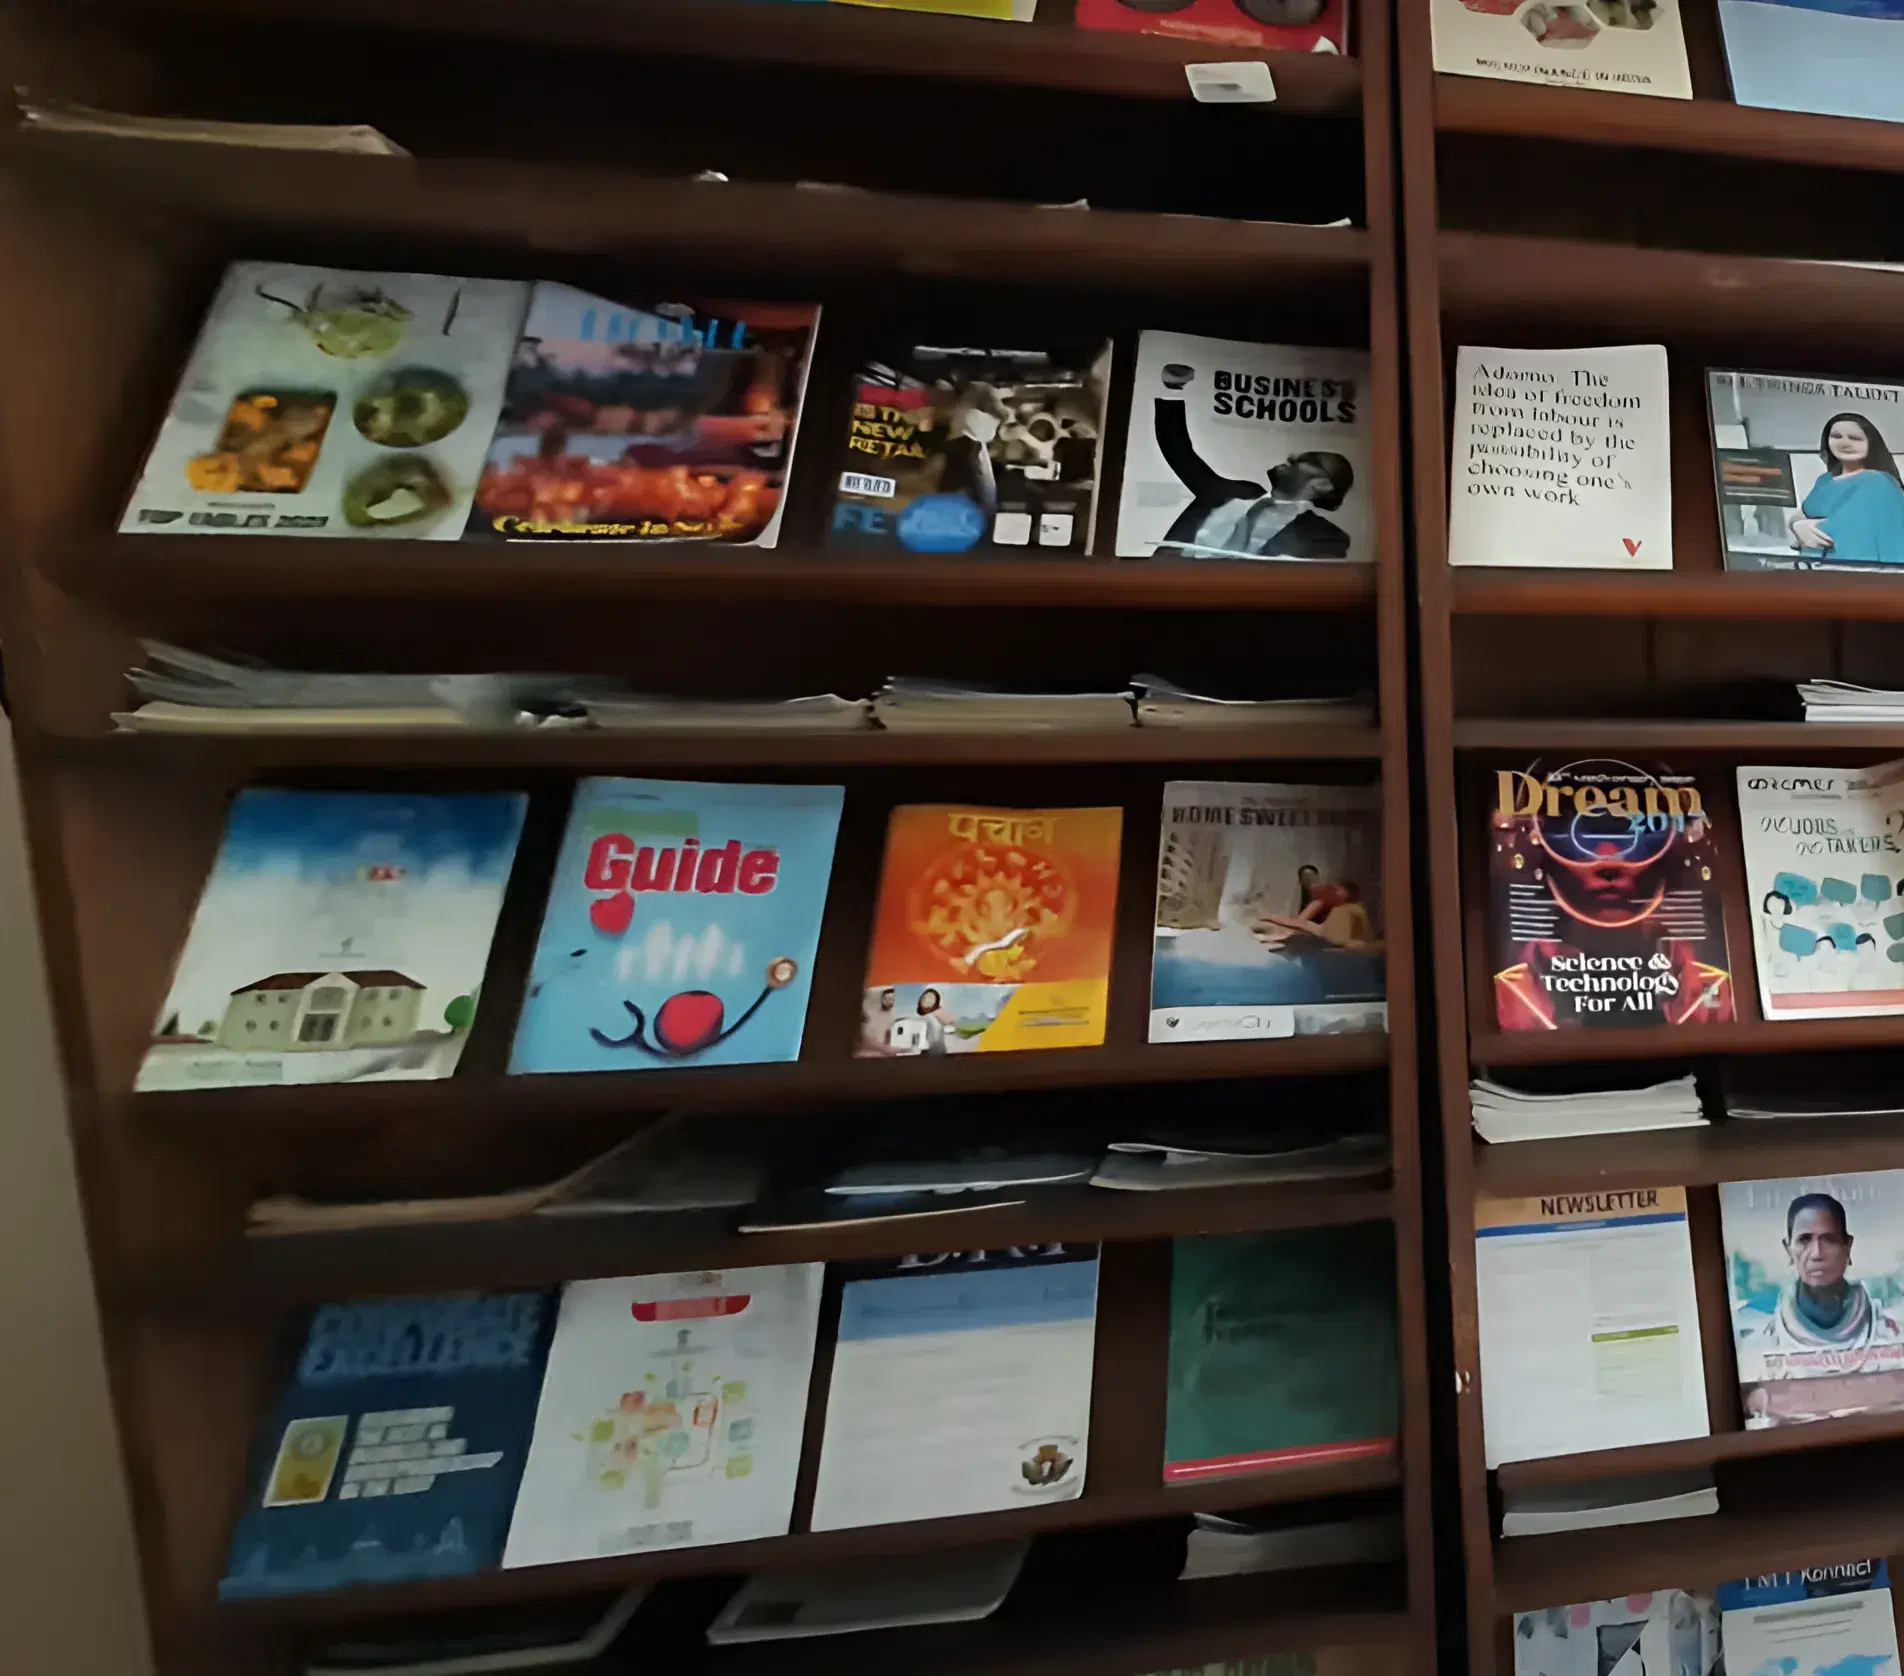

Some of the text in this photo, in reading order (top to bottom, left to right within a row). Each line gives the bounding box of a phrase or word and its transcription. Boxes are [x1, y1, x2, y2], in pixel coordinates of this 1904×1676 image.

[1213, 370, 1358, 400] BUSINESS
[1571, 370, 1609, 387] The
[1213, 392, 1358, 424] SCHOOLS
[1525, 388, 1548, 403] of
[1555, 388, 1642, 409] freedom
[1472, 402, 1625, 429] from labour is
[852, 420, 914, 441] NEW
[1471, 422, 1636, 451] replaced by the
[1469, 443, 1616, 469] possibility of
[1467, 459, 1569, 488] choosing
[1467, 482, 1516, 498] own
[1494, 769, 1702, 818] Dream
[584, 833, 780, 896] Guide
[1550, 952, 1672, 973] Science &
[1540, 972, 1680, 996] Technology
[1575, 991, 1654, 1014] For All
[1540, 1188, 1661, 1216] NEWSLETTER
